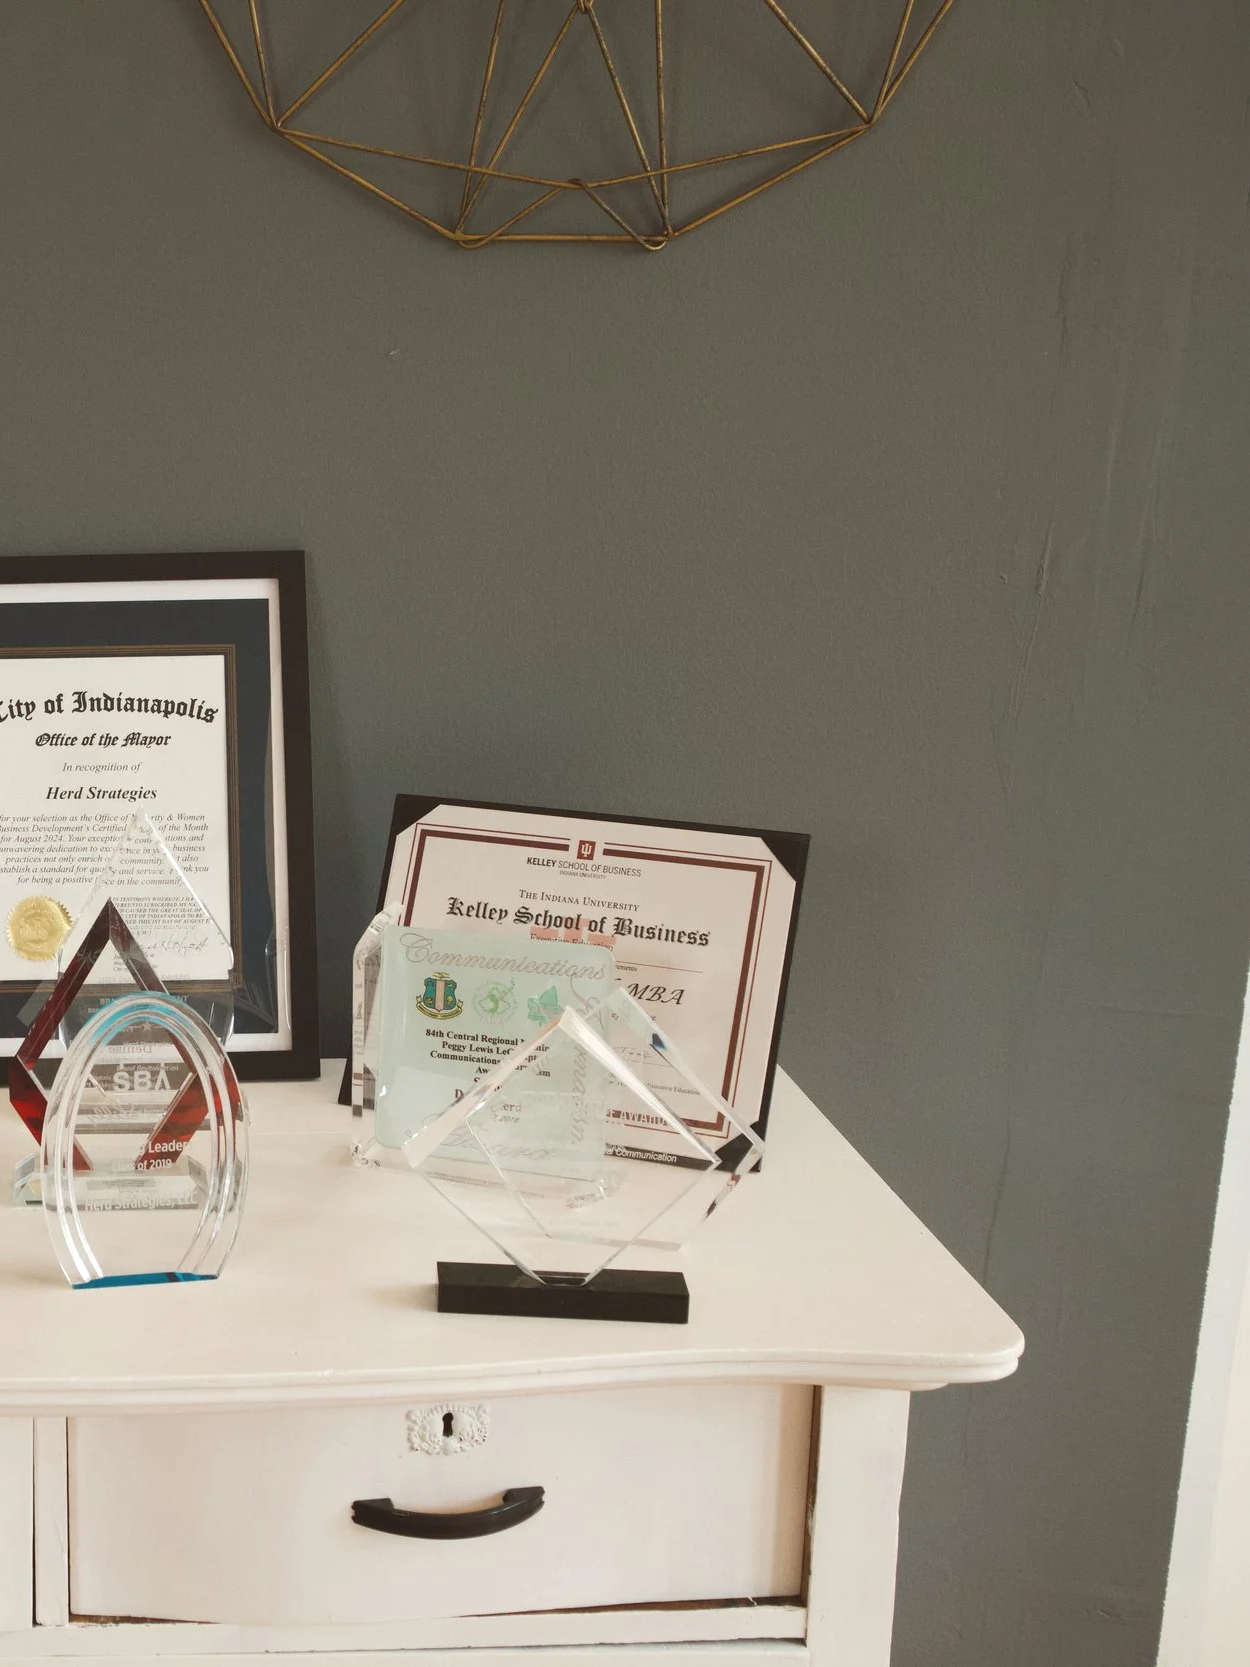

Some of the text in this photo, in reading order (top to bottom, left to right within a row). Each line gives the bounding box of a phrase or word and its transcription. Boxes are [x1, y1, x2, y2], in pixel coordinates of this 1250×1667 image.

[44, 693, 64, 714] of
[72, 690, 219, 723] Indianapolis
[36, 732, 171, 748] Office of the Mayor
[62, 762, 142, 774] In recognition of
[46, 786, 158, 802] Herd Strategies
[12, 816, 31, 824] your
[32, 814, 67, 822] selection
[80, 814, 92, 822] the
[94, 814, 119, 823] Office
[120, 813, 130, 823] of
[178, 813, 205, 821] Women
[32, 824, 90, 834] Development's
[92, 824, 127, 832] Certified
[159, 824, 168, 832] of
[168, 823, 181, 832] the
[183, 823, 209, 832] Month
[14, 835, 42, 844] August
[68, 834, 87, 842] Your
[188, 834, 205, 842] and
[46, 845, 88, 853] dedication
[90, 845, 98, 853] to
[143, 847, 151, 855] in
[172, 844, 206, 852] business
[5, 856, 42, 865] practices
[58, 854, 76, 865] only
[78, 854, 103, 863] enrich
[182, 854, 199, 862] also
[40, 865, 75, 873] standard
[75, 865, 88, 875] for
[194, 866, 210, 874] you
[527, 857, 642, 877] KELLEY SCHOOL OF BUSINESS
[17, 876, 30, 886] for
[32, 875, 54, 885] being
[62, 876, 93, 885] positive
[117, 878, 125, 886] in
[127, 877, 138, 885] the
[579, 872, 607, 880] UNIVERSITY
[519, 890, 640, 912] THE INDIANA UNIVERSITY
[446, 897, 711, 947] Kelley School of Business
[400, 932, 607, 981] Communications
[627, 982, 686, 1006] MBA
[426, 1028, 445, 1038] 84th
[446, 1031, 479, 1042] Central
[481, 1034, 519, 1046] Regional
[442, 1041, 467, 1053] Peggy
[470, 1044, 494, 1054] Lewis
[616, 1147, 678, 1163] Communication
[138, 1160, 148, 1171] of
[150, 1158, 172, 1170] 2019
[85, 1200, 115, 1213] Herd
[115, 1196, 175, 1210] Strategies,
